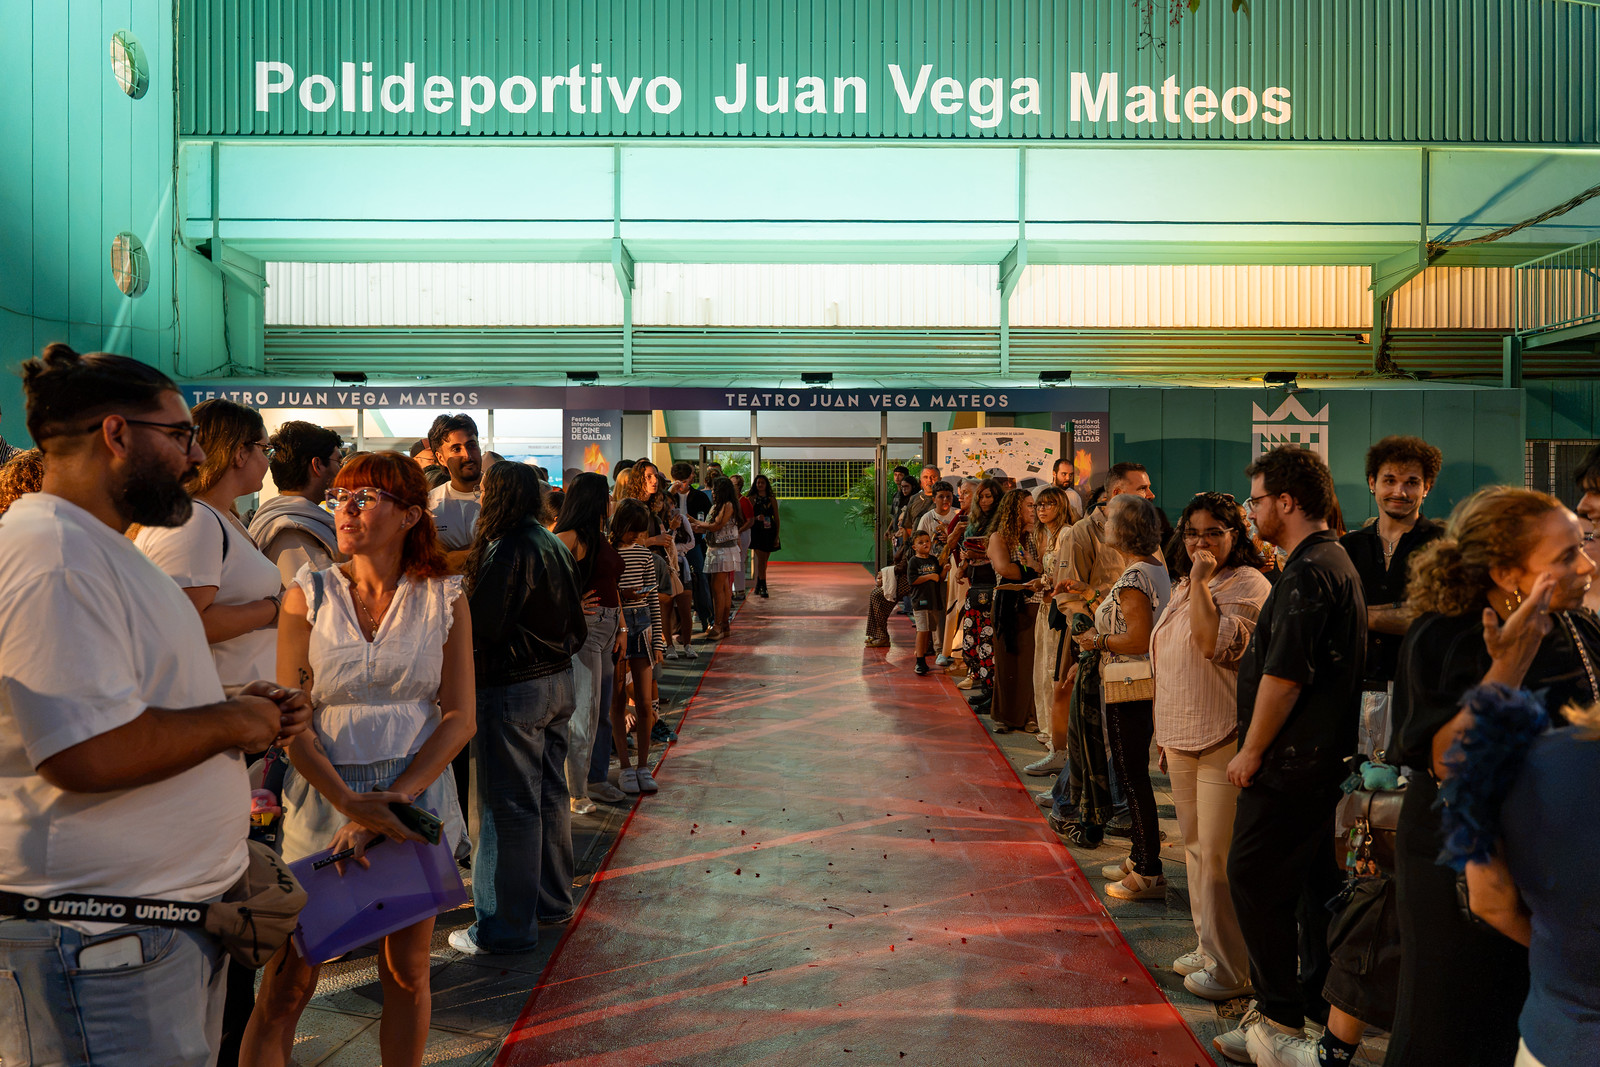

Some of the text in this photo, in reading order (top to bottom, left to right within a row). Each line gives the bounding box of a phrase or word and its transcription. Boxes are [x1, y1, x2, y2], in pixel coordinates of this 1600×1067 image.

[255, 61, 1292, 129] Polideportivo Juan Vega Mateos
[193, 391, 479, 406] TEATRO JUAN VEGA MATEOS
[725, 393, 1009, 408] TEATRO JUAN VEGA MATEOS
[48, 897, 127, 918] umbro
[135, 903, 201, 922] umbro
